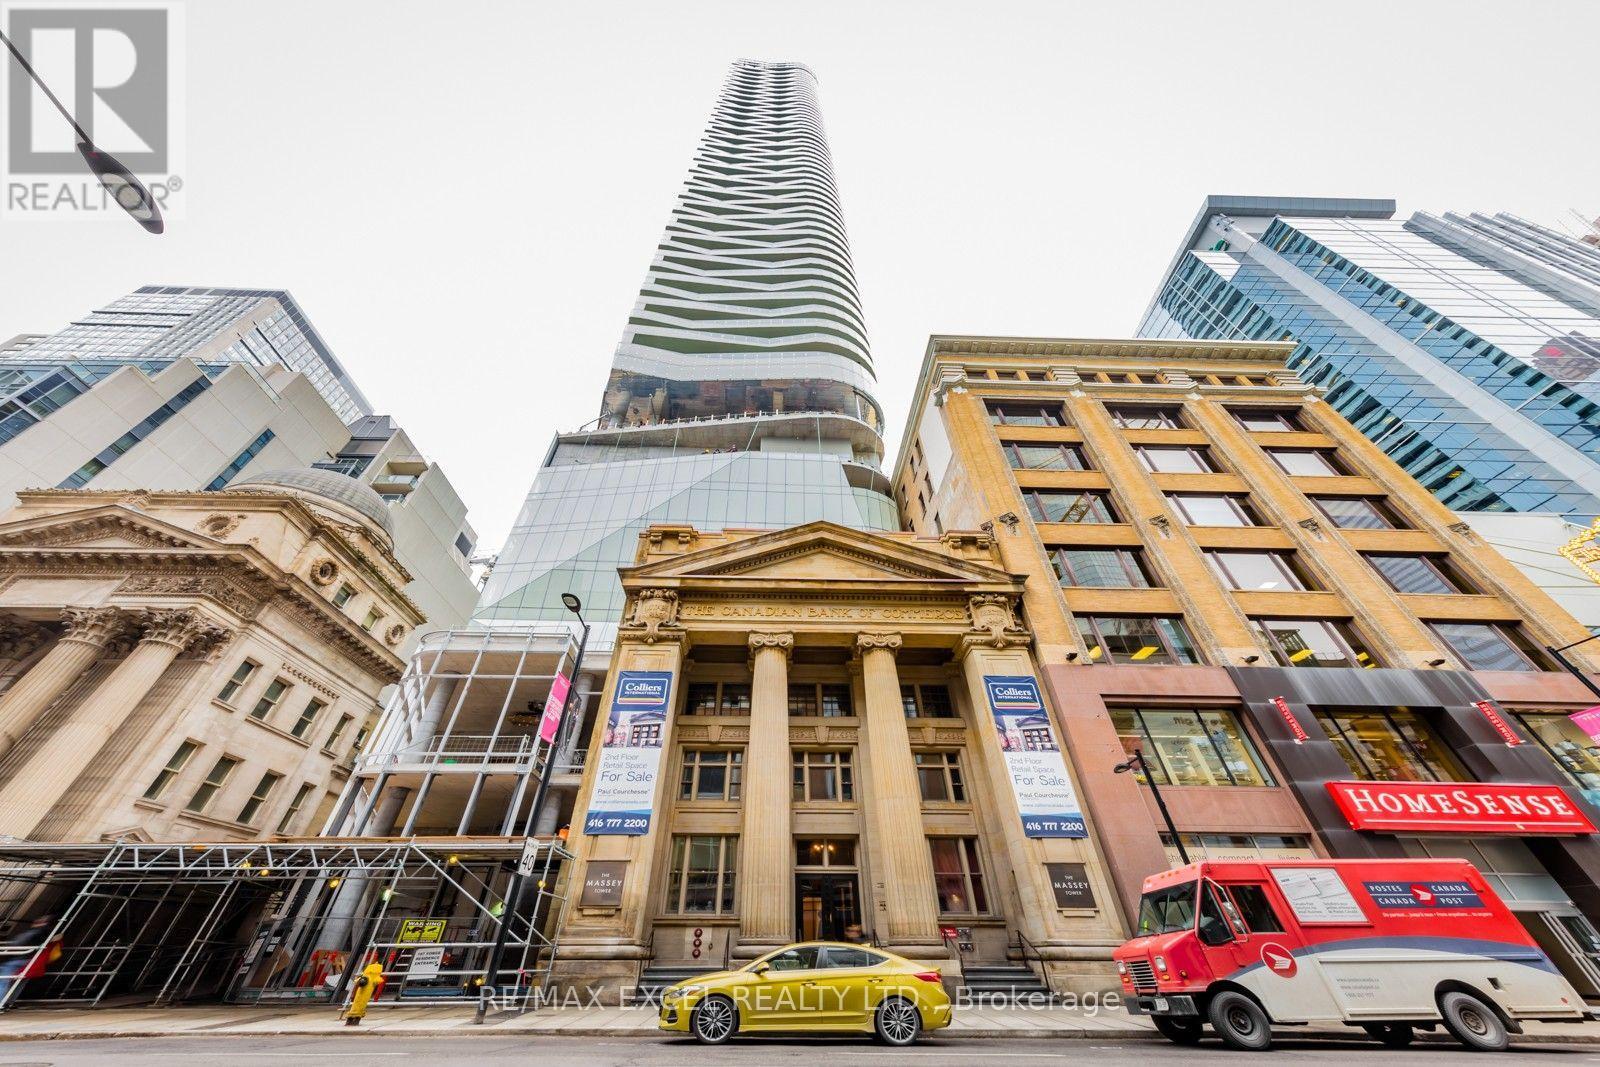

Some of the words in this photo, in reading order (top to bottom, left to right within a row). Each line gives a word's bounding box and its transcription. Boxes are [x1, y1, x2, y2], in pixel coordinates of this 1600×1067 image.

[685, 606, 715, 616] THE
[721, 606, 802, 617] CANADIAN
[807, 606, 853, 618] BANK
[860, 607, 877, 618] OF
[882, 607, 964, 620] COMMERCE
[625, 683, 662, 692] Colliers
[995, 687, 1032, 696] Colliers
[603, 761, 623, 769] Retail
[625, 762, 648, 770] Space
[1032, 766, 1055, 774] Space
[601, 770, 623, 782] For
[626, 771, 653, 782] Sale
[1014, 774, 1035, 785] For
[1038, 775, 1066, 786] Sale
[1344, 788, 1575, 817] HOMESENSE
[588, 819, 604, 828] 416
[606, 819, 622, 828] 777
[623, 819, 648, 828] 2200
[1026, 821, 1041, 831] 416
[1042, 821, 1058, 831] 777
[1060, 822, 1084, 831] 2200
[522, 853, 535, 871] 40
[1378, 897, 1416, 905] CANADA
[1440, 897, 1464, 905] POST
